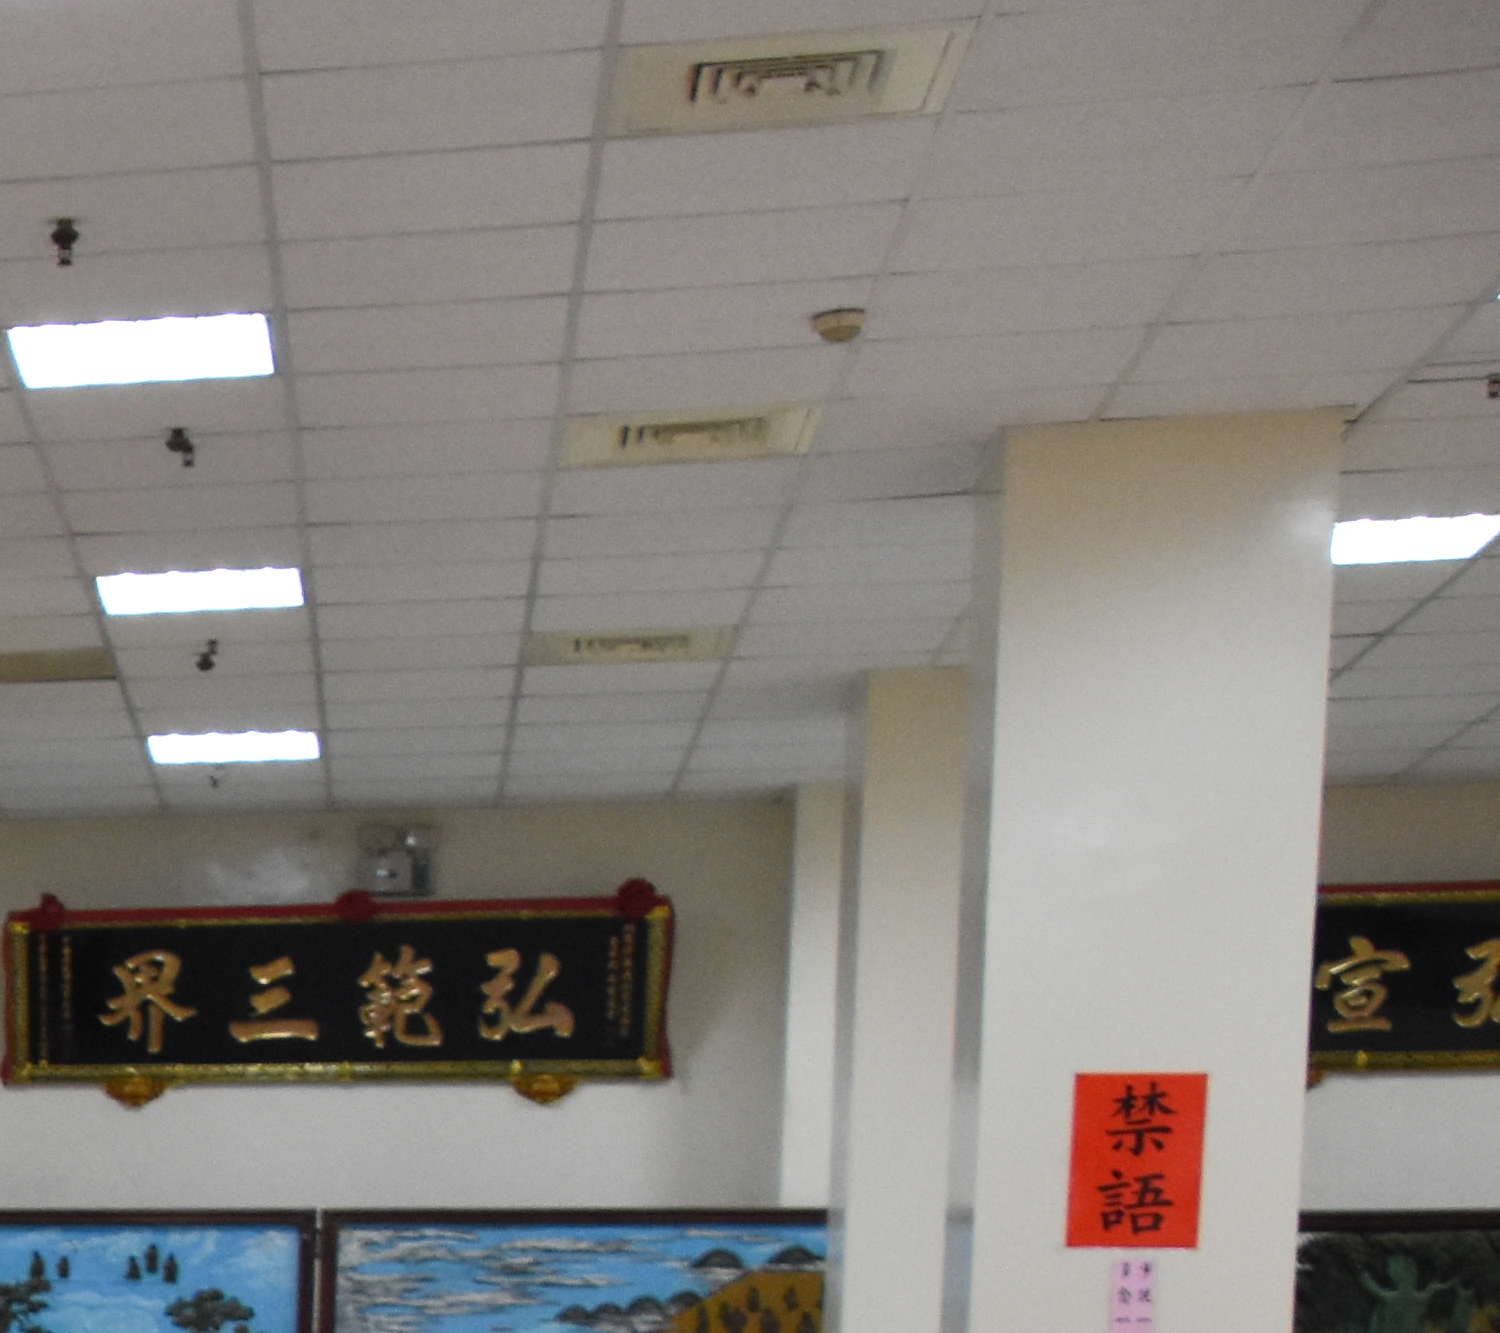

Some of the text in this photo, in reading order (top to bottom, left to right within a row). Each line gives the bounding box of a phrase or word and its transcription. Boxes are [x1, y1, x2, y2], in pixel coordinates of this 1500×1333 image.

[98, 945, 576, 1054] 弘範三界
[1097, 1080, 1178, 1236] 禁語
